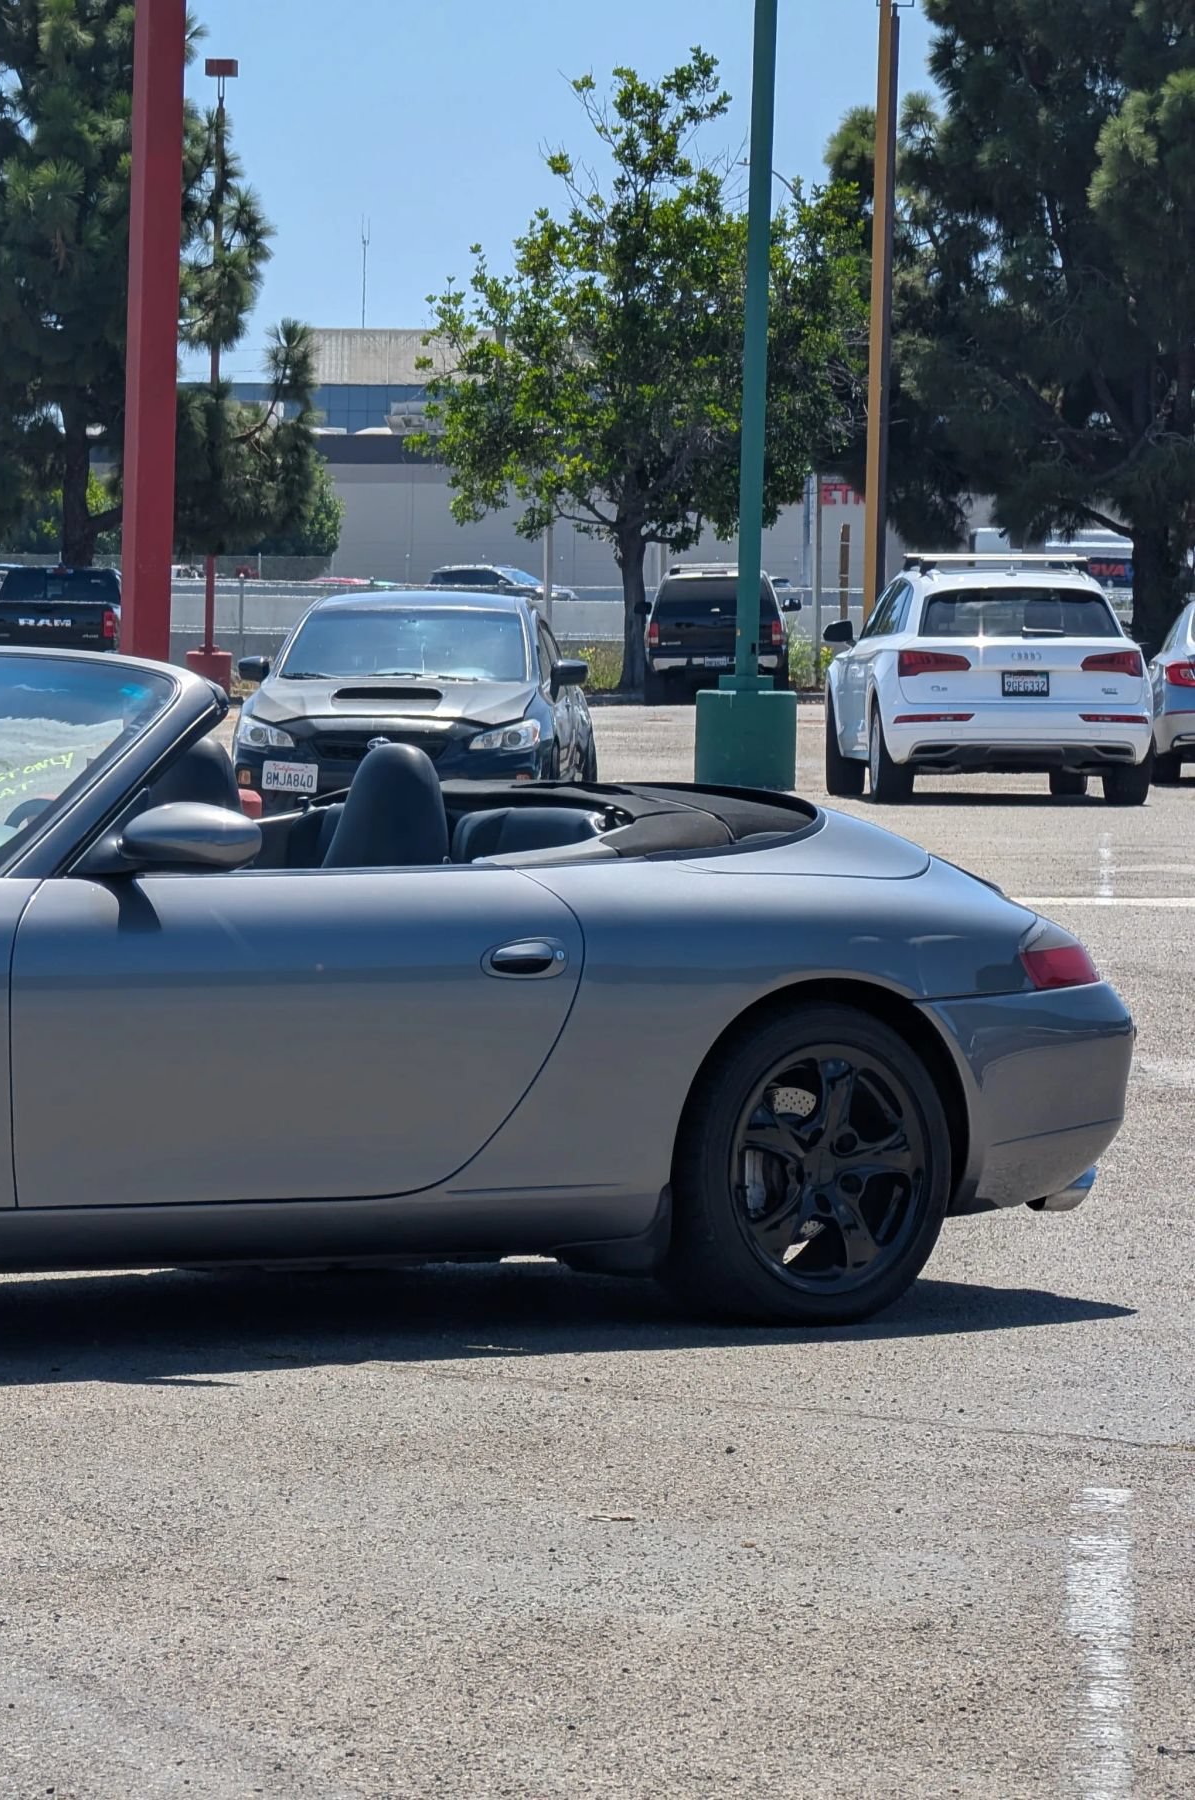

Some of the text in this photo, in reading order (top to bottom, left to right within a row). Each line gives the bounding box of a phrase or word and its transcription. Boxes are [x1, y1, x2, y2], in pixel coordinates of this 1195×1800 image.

[18, 618, 72, 628] RAM
[23, 752, 74, 774] ONLY
[265, 772, 314, 788] 8MJA840
